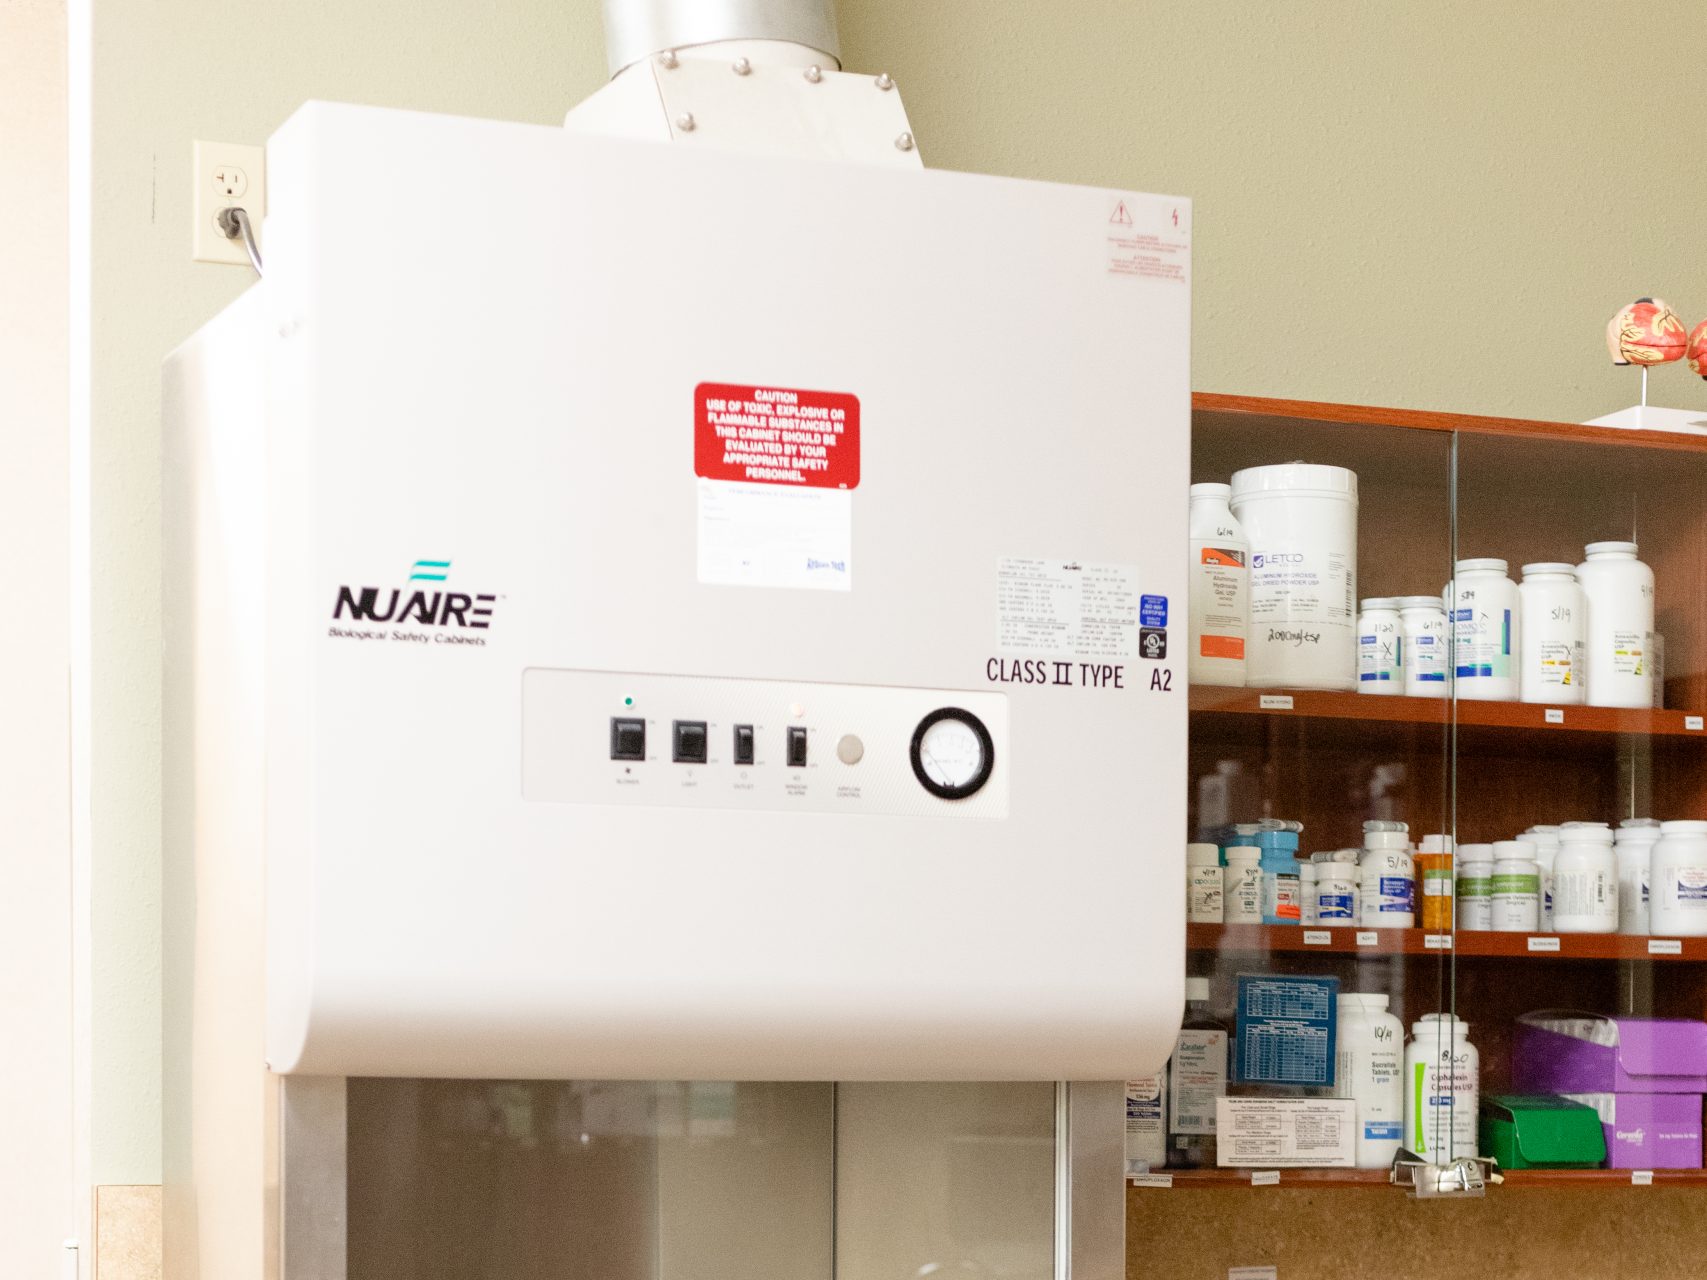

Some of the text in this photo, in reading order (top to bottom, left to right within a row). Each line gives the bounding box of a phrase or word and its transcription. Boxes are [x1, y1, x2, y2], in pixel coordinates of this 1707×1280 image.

[754, 389, 798, 403] CAUTION
[706, 399, 726, 411] USE
[728, 400, 742, 412] OF
[776, 404, 828, 418] EXPLOSIVE
[830, 409, 845, 420] OR
[708, 412, 844, 433] FLAMMABLE SUBSTANCES IN
[715, 425, 836, 446] THIS CABINET SHOULD BE
[725, 439, 826, 457] EVALUATED BY YOUR
[723, 452, 828, 471] APPROPRIATE SAFETY
[333, 586, 496, 628] NUAIRE
[328, 627, 486, 646] Biological Safety Cabinets
[986, 658, 1172, 692] CLASS II TYPE A2
[1387, 856, 1408, 868] 5/19
